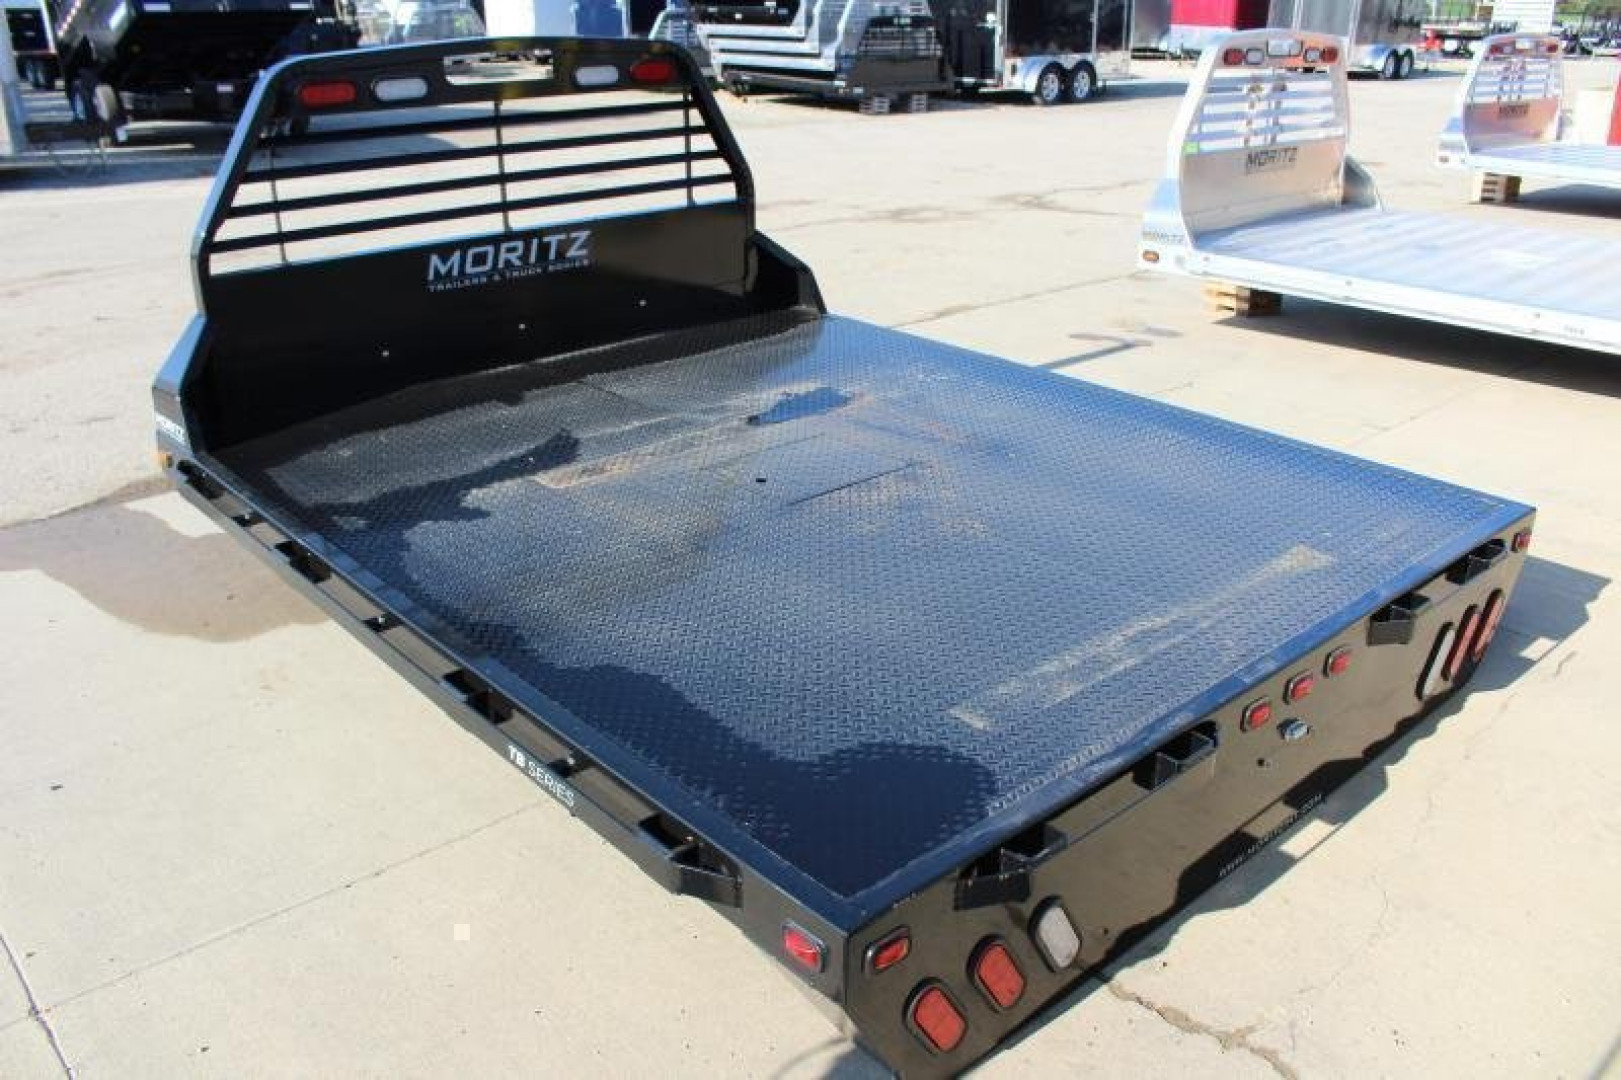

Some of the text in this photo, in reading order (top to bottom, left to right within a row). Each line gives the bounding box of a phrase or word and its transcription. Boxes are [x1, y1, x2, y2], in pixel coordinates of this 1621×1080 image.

[1246, 147, 1298, 169] MORITZ
[427, 230, 592, 281] MORITZ
[427, 276, 488, 293] TRAILERS
[504, 267, 543, 279] TRUCK
[528, 761, 574, 808] SERIES
